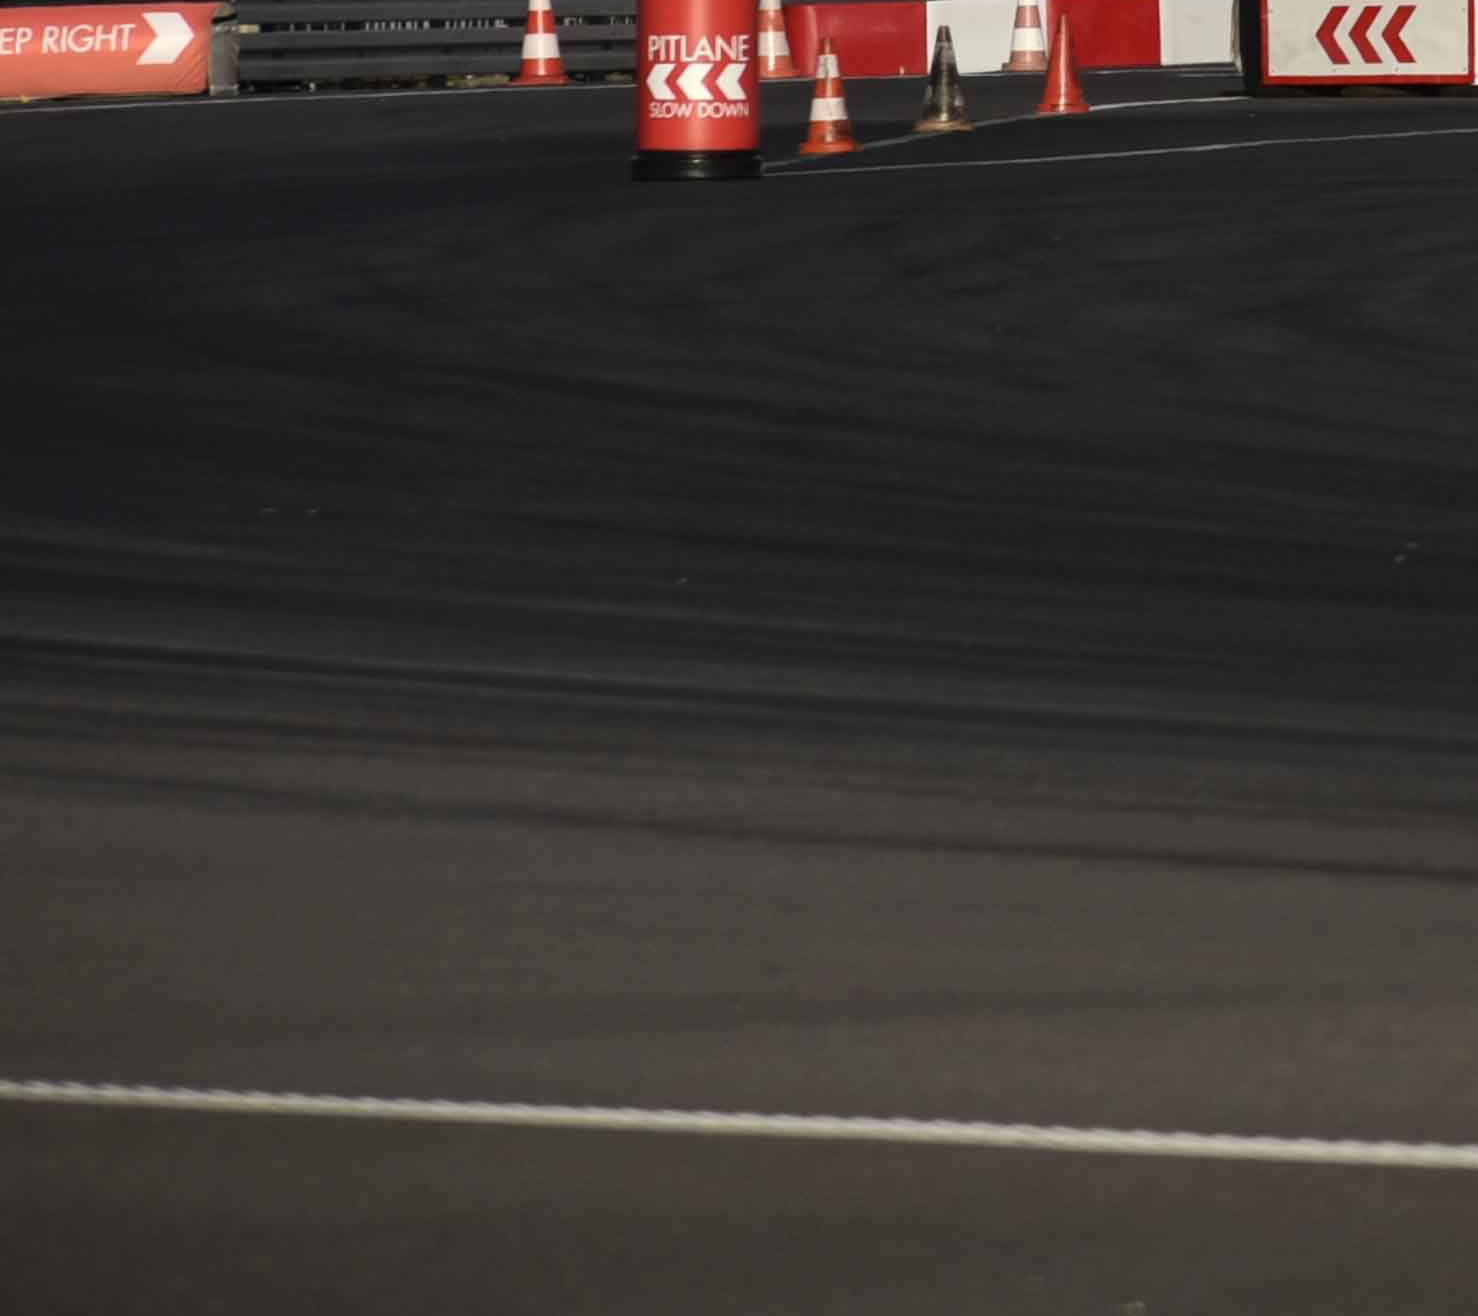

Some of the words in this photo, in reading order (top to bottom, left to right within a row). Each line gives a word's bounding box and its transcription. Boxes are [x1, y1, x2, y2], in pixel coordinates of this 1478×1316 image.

[41, 23, 136, 55] RIGHT
[648, 35, 750, 62] PITLANE
[649, 102, 693, 119] SLOW
[697, 101, 750, 118] DOWN
